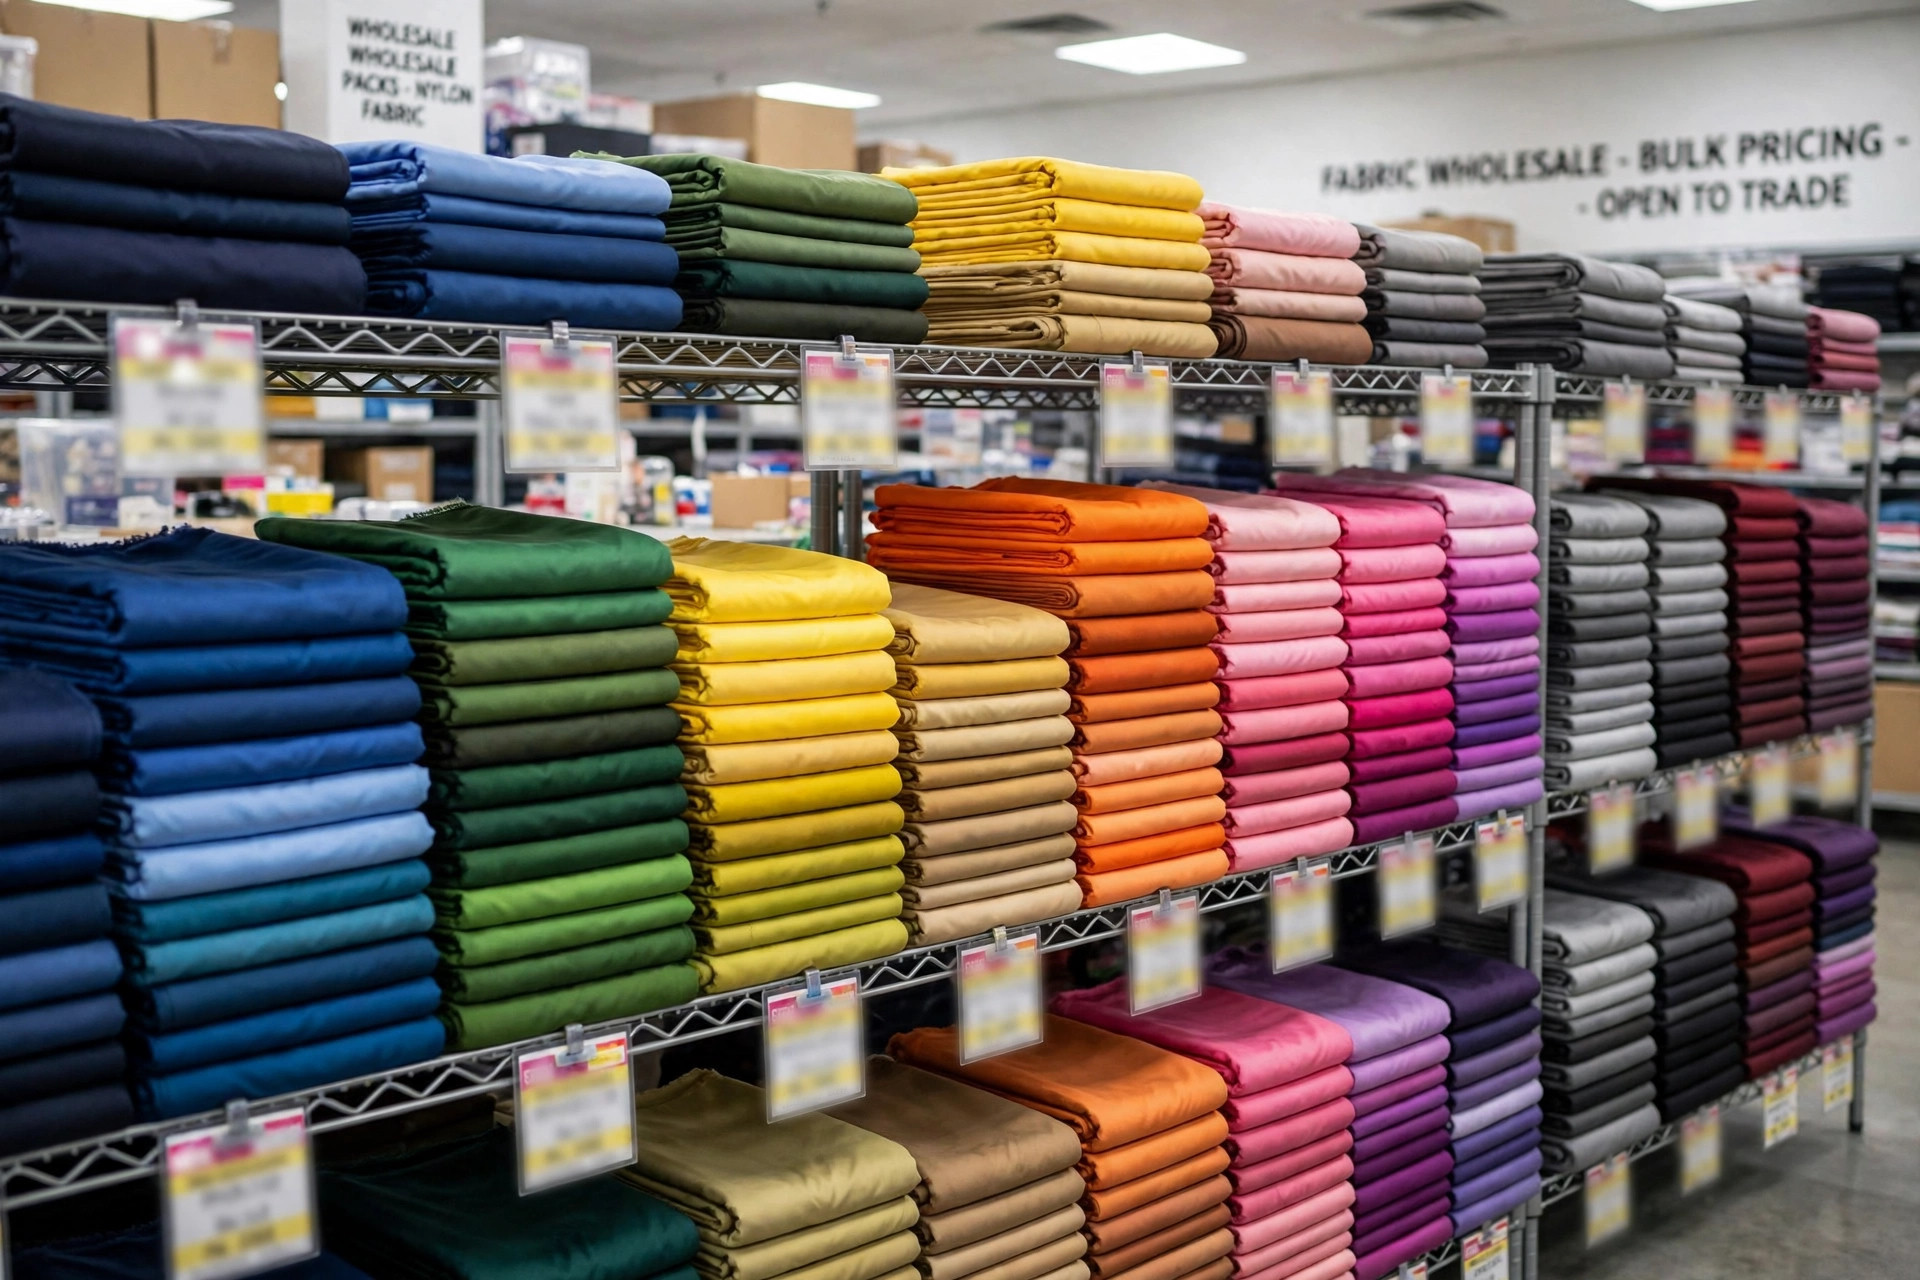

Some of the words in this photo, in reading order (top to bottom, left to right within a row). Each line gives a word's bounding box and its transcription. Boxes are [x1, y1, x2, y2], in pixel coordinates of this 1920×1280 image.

[348, 18, 456, 49] WHOLESALE
[348, 46, 457, 77] WHOLESALE
[342, 70, 398, 96] PACKS
[415, 81, 473, 104] NYLON
[362, 100, 425, 126] FABRIC
[1321, 159, 1416, 194] FABRIC
[1424, 142, 1608, 185] WHOLESALE
[1639, 135, 1727, 172] BULK
[1736, 122, 1882, 167] PRICING
[1597, 184, 1681, 218] OPEN
[1691, 181, 1731, 213] TO
[1740, 174, 1851, 211] TRADE
